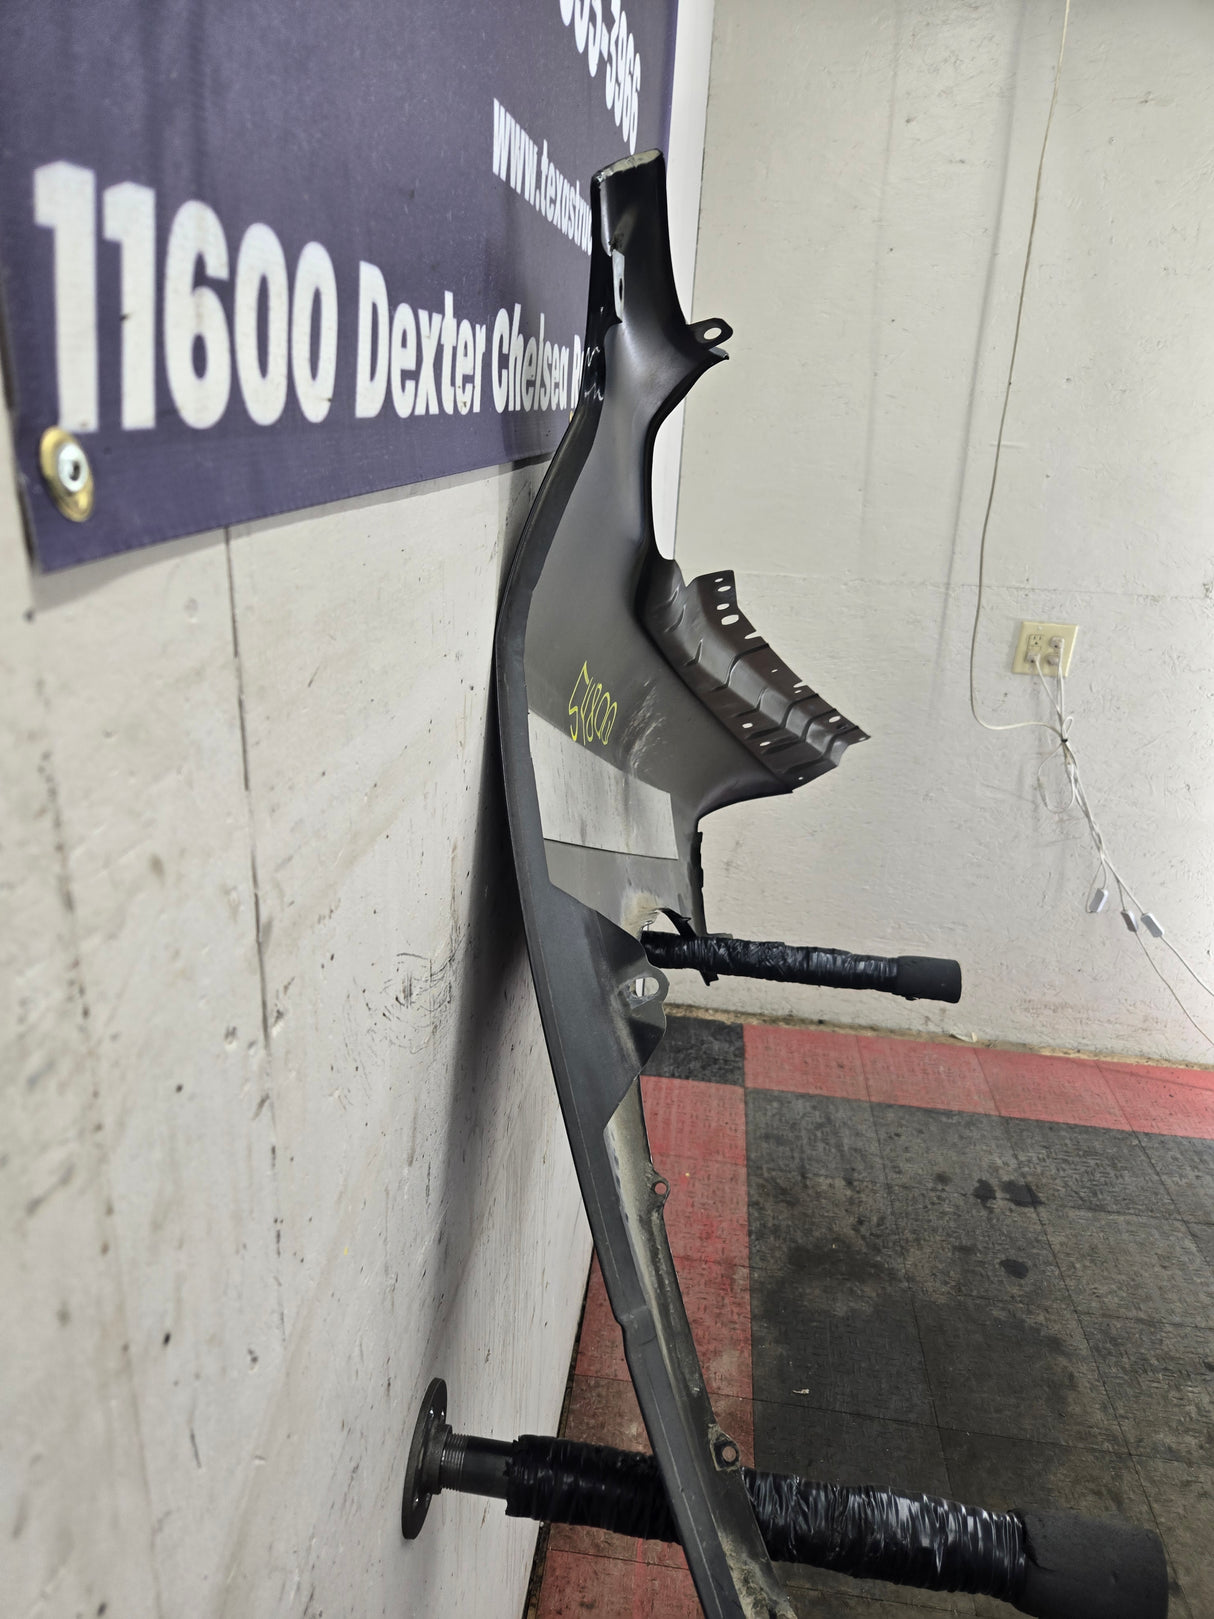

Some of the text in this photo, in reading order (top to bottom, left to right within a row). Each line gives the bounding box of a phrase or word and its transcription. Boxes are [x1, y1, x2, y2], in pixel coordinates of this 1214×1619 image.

[559, 0, 641, 156] 3-3966
[493, 97, 592, 256] www.texastruc
[33, 160, 585, 433] 11600 Dexter Chelsea R
